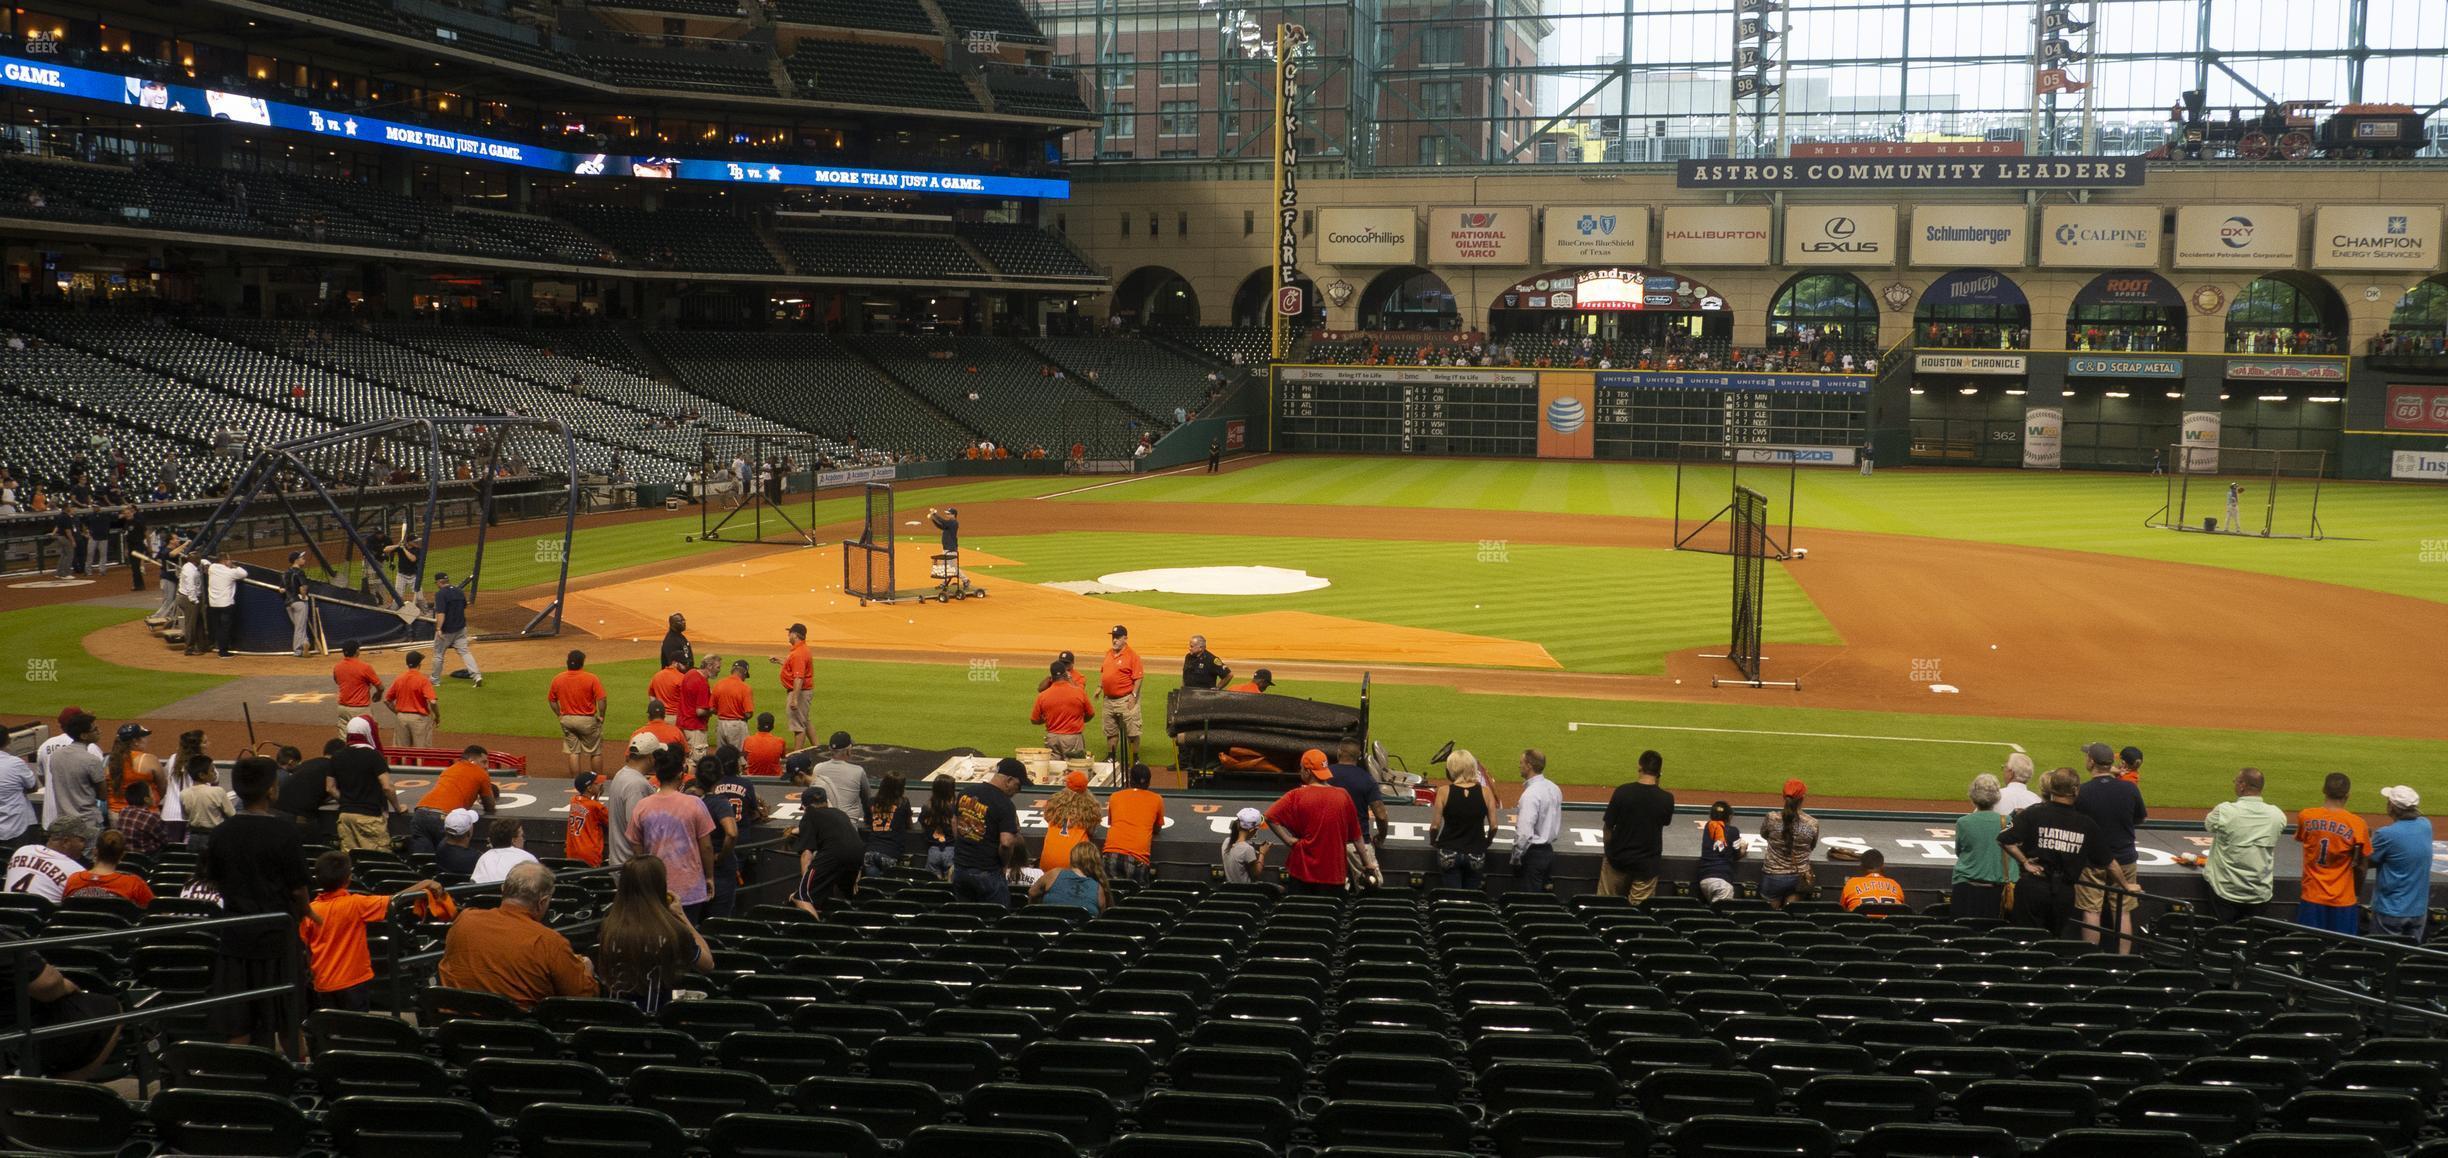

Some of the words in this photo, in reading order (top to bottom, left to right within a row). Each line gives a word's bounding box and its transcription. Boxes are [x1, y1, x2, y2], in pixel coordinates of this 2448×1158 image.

[2046, 14, 2062, 27] 01
[2045, 43, 2061, 57] 04
[5, 64, 65, 88] GAME.
[2043, 74, 2060, 88] 05
[1738, 79, 1753, 92] 98
[386, 126, 423, 145] MORE
[424, 130, 455, 150] THAN
[457, 134, 479, 154] JUST
[479, 142, 489, 155] A
[489, 142, 523, 161] GAME.
[1814, 146, 1911, 154] MINUTE
[1937, 145, 2001, 154] MAID
[1694, 164, 1795, 181] ASTROS
[1807, 163, 1985, 180] COMMUNITY
[1998, 163, 2127, 179] LEADERS
[747, 168, 762, 179] vs.
[815, 170, 860, 184] MORE
[861, 172, 898, 187] THAN
[899, 174, 928, 188] JUST
[929, 177, 940, 188] A
[941, 176, 985, 191] GAME.
[1328, 231, 1405, 247] ConocoPhillips
[1451, 231, 1506, 239] NATIONAL
[1666, 231, 1767, 239] HALLIBURTON
[1926, 225, 2011, 245] Schlumberger
[2080, 229, 2147, 241] CALPINE
[2221, 228, 2254, 237] OXY
[1455, 240, 1502, 248] OILWELL
[1801, 242, 1879, 253] LEXUS
[2332, 235, 2423, 248] CHAMPION
[1460, 249, 1496, 258] VARCO
[2332, 249, 2371, 258] ENERGY
[2373, 250, 2422, 258] SERVICES
[1579, 267, 1645, 284] Landry's
[2107, 279, 2153, 292] ROOT
[1921, 358, 1963, 367] HOUSTON
[1971, 358, 2020, 369] CHRONICLE
[2076, 361, 2085, 372] C
[2086, 361, 2095, 372] &
[2097, 361, 2107, 372] D
[2111, 362, 2142, 372] SCRAP
[2144, 363, 2176, 373] METAL
[1251, 368, 1269, 377] 315
[1339, 372, 1355, 380] Bring
[1434, 374, 1451, 382] Bring
[2398, 406, 2418, 416] 66
[1404, 389, 1412, 449] NATIONAL
[1992, 431, 2016, 441] 362
[1059, 818, 1070, 837] 1
[2304, 819, 2354, 840] CORREA
[2038, 826, 2085, 844] PLATINUM
[2037, 837, 2083, 854] SECURITY
[2317, 838, 2330, 865] 1
[7, 855, 69, 887] SPRINGER
[11, 873, 35, 893] 4
[1855, 881, 1898, 895] ALTUVE
